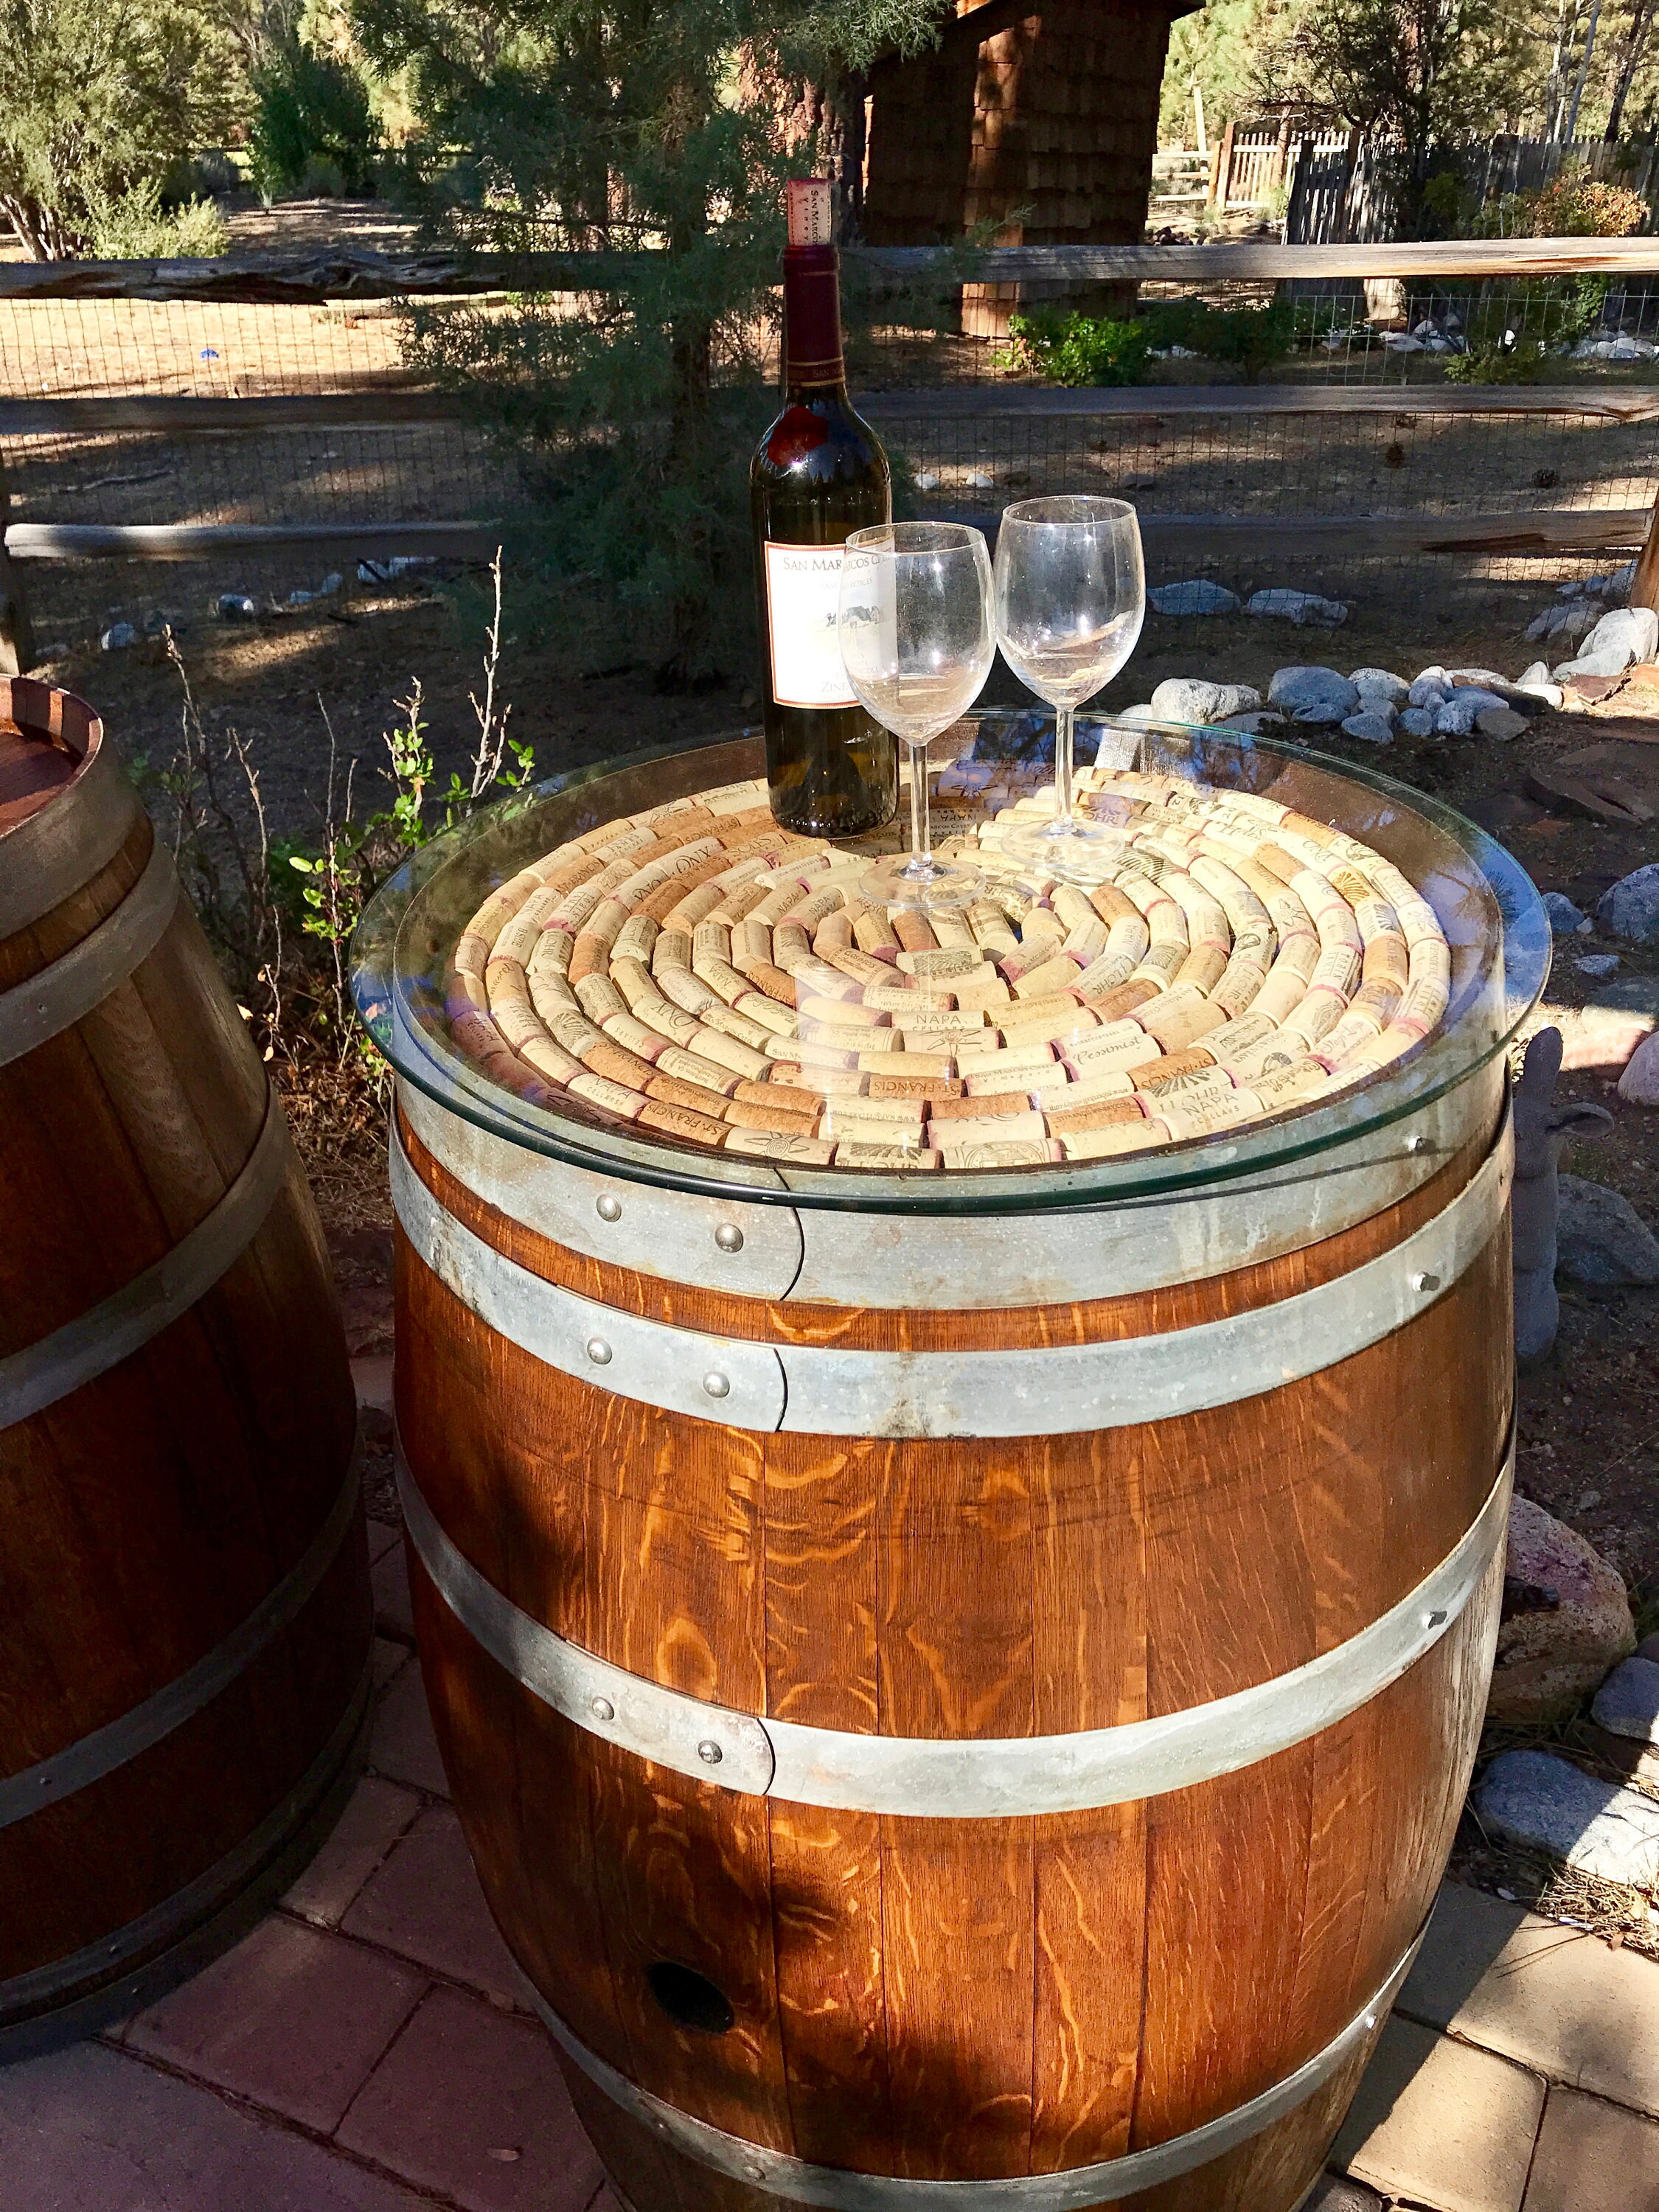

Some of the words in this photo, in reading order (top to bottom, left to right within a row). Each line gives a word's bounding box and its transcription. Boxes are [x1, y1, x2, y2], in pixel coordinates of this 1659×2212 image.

[782, 557, 807, 571] SAN
[775, 892, 800, 915] NAPA
[807, 894, 832, 916] NAPA
[916, 1015, 961, 1024] NAPA
[613, 1026, 647, 1048] CELLARS
[585, 1085, 619, 1105] CELLARS
[589, 1074, 630, 1099] NAPA
[874, 1079, 934, 1093] FRANCIS
[647, 1099, 701, 1130] FRANCIS
[1181, 1091, 1238, 1118] NAPA
